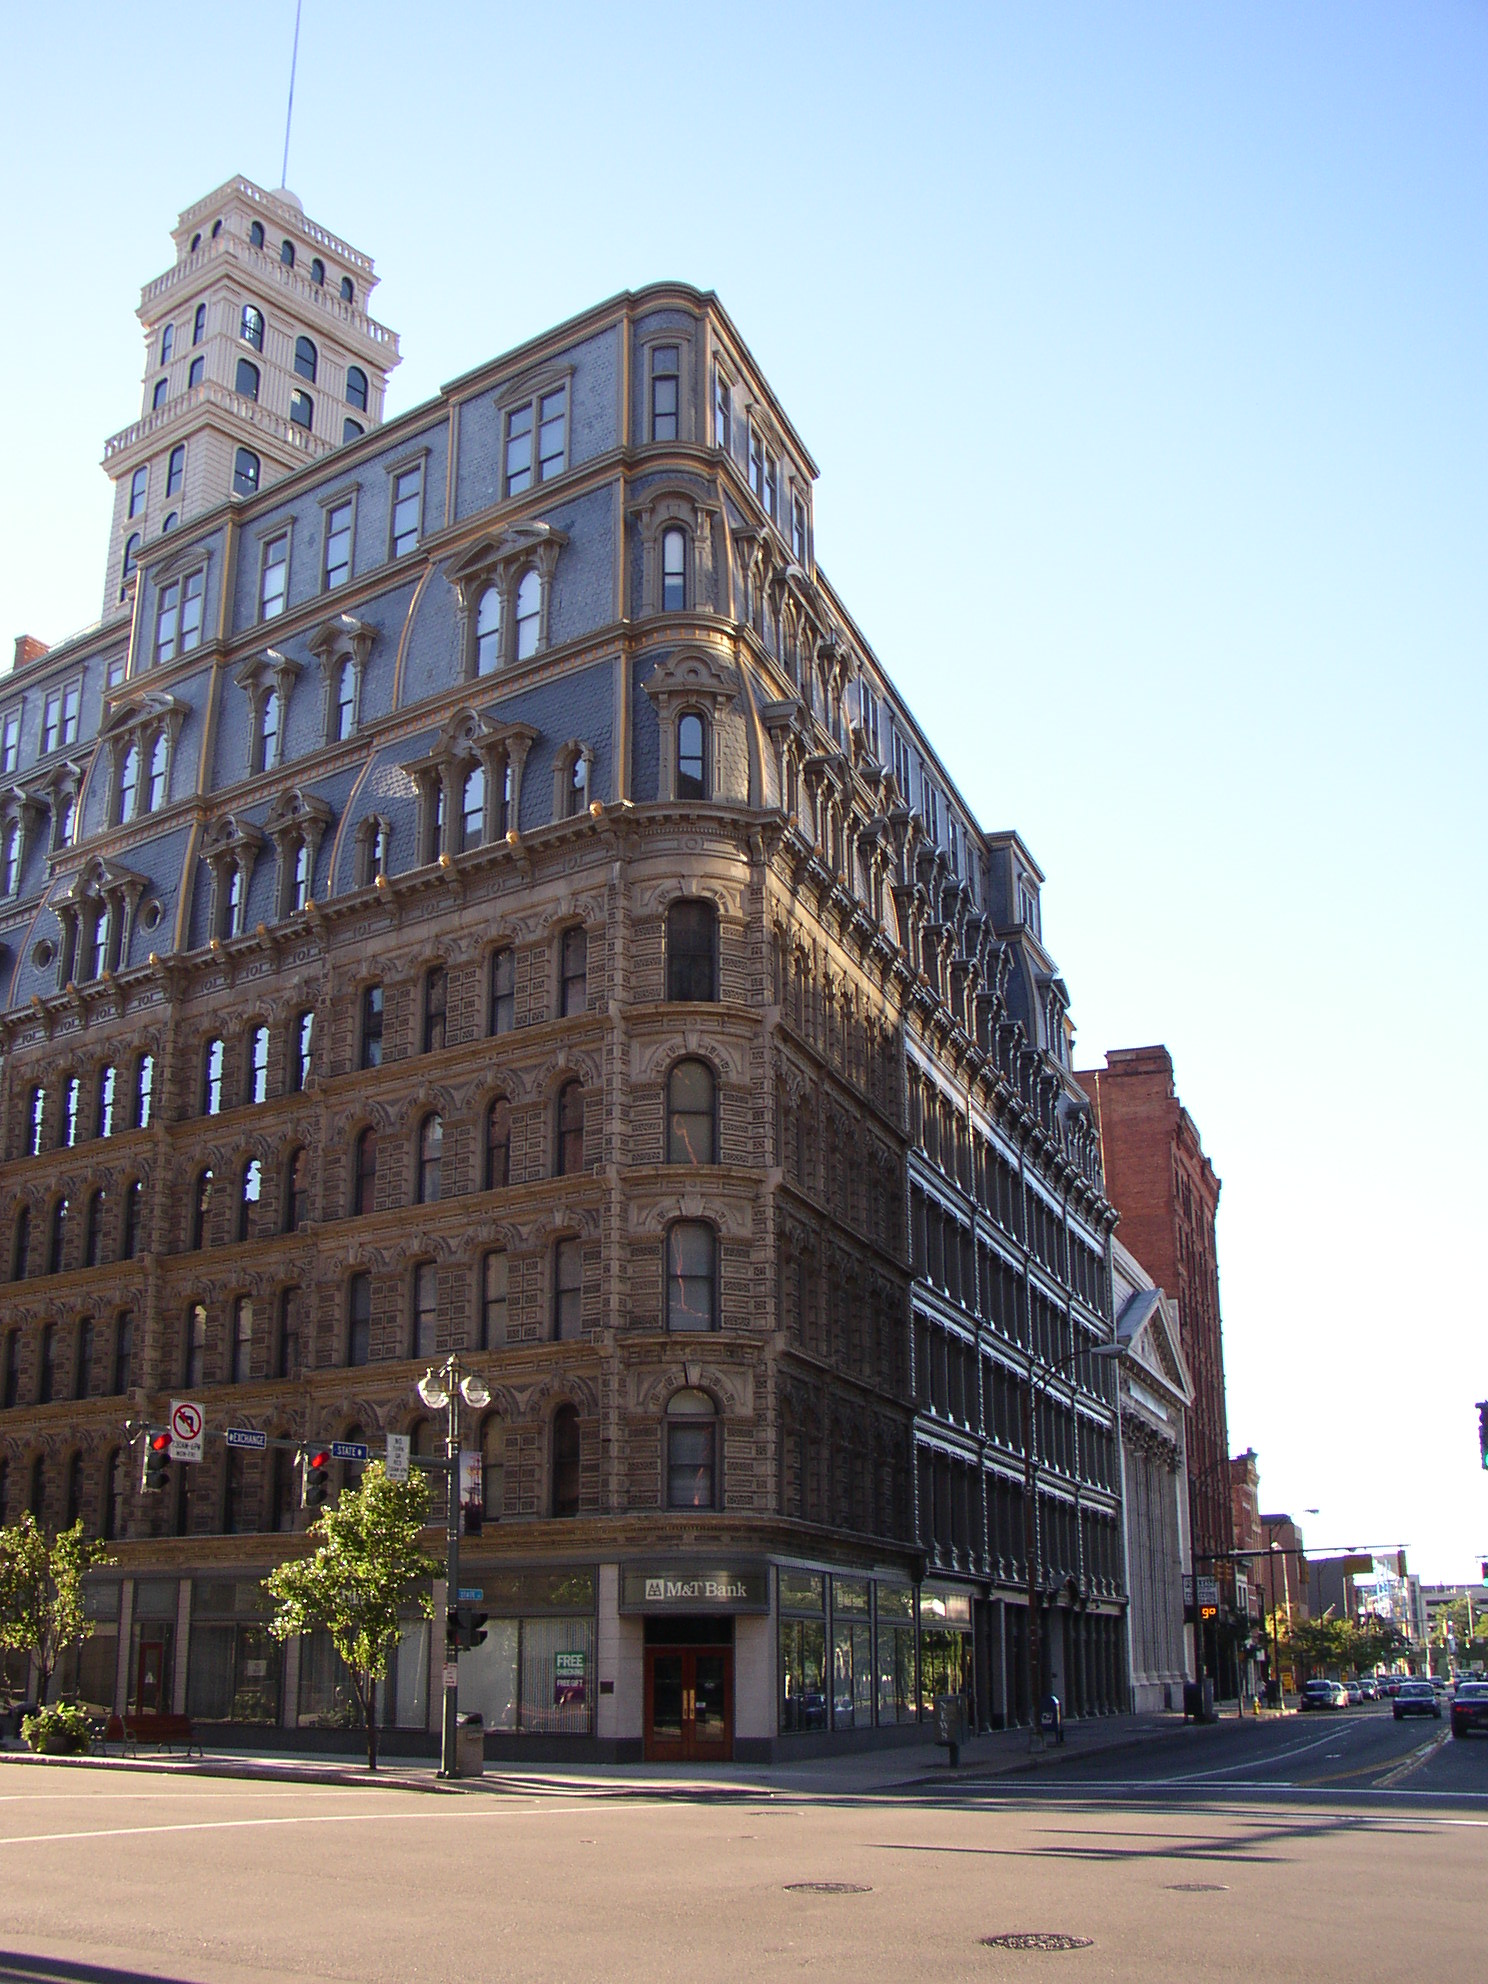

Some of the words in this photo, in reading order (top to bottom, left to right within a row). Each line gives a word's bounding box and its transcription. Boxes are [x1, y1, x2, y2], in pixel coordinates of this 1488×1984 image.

[232, 1431, 264, 1446] EXCHANGE
[337, 1445, 357, 1457] STATE
[666, 1581, 703, 1597] M&T
[704, 1581, 747, 1597] Bank
[557, 1654, 583, 1667] FREE
